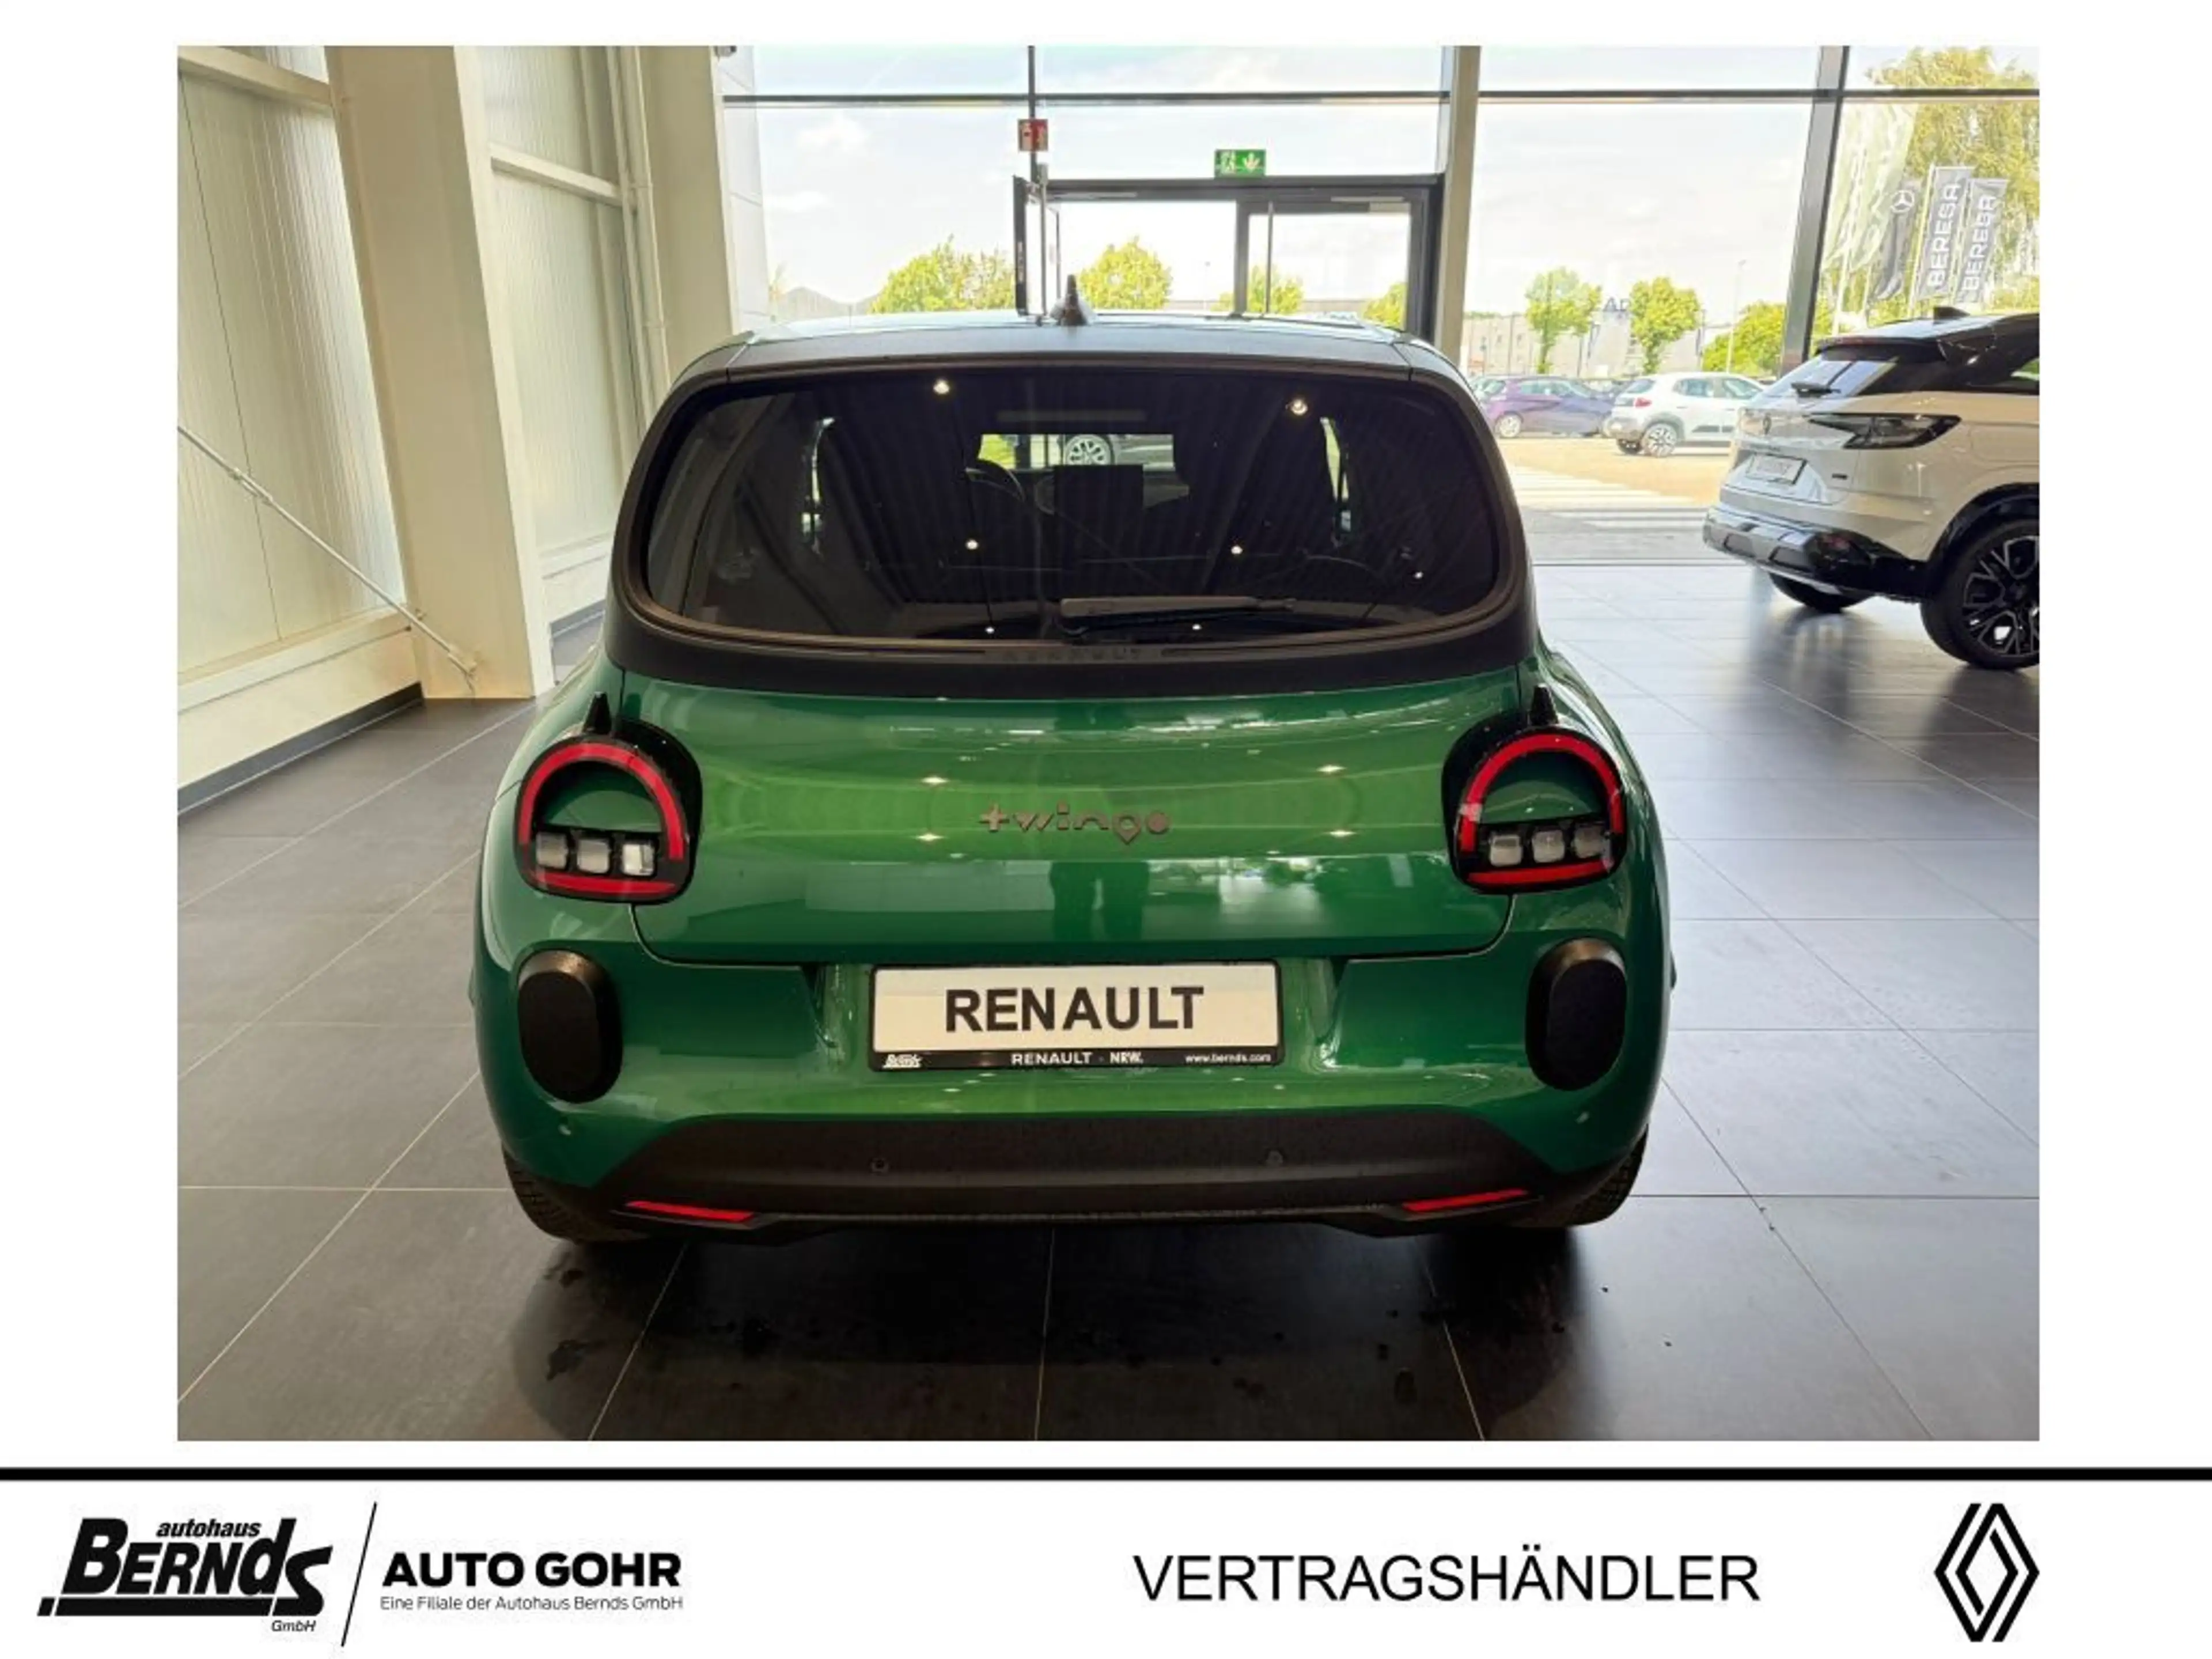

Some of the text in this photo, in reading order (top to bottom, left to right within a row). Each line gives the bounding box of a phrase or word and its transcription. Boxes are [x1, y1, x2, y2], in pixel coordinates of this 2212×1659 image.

[1927, 184, 1962, 287] BERESA
[945, 987, 1204, 1032] RENAULT
[1011, 1051, 1093, 1065] RENAULT
